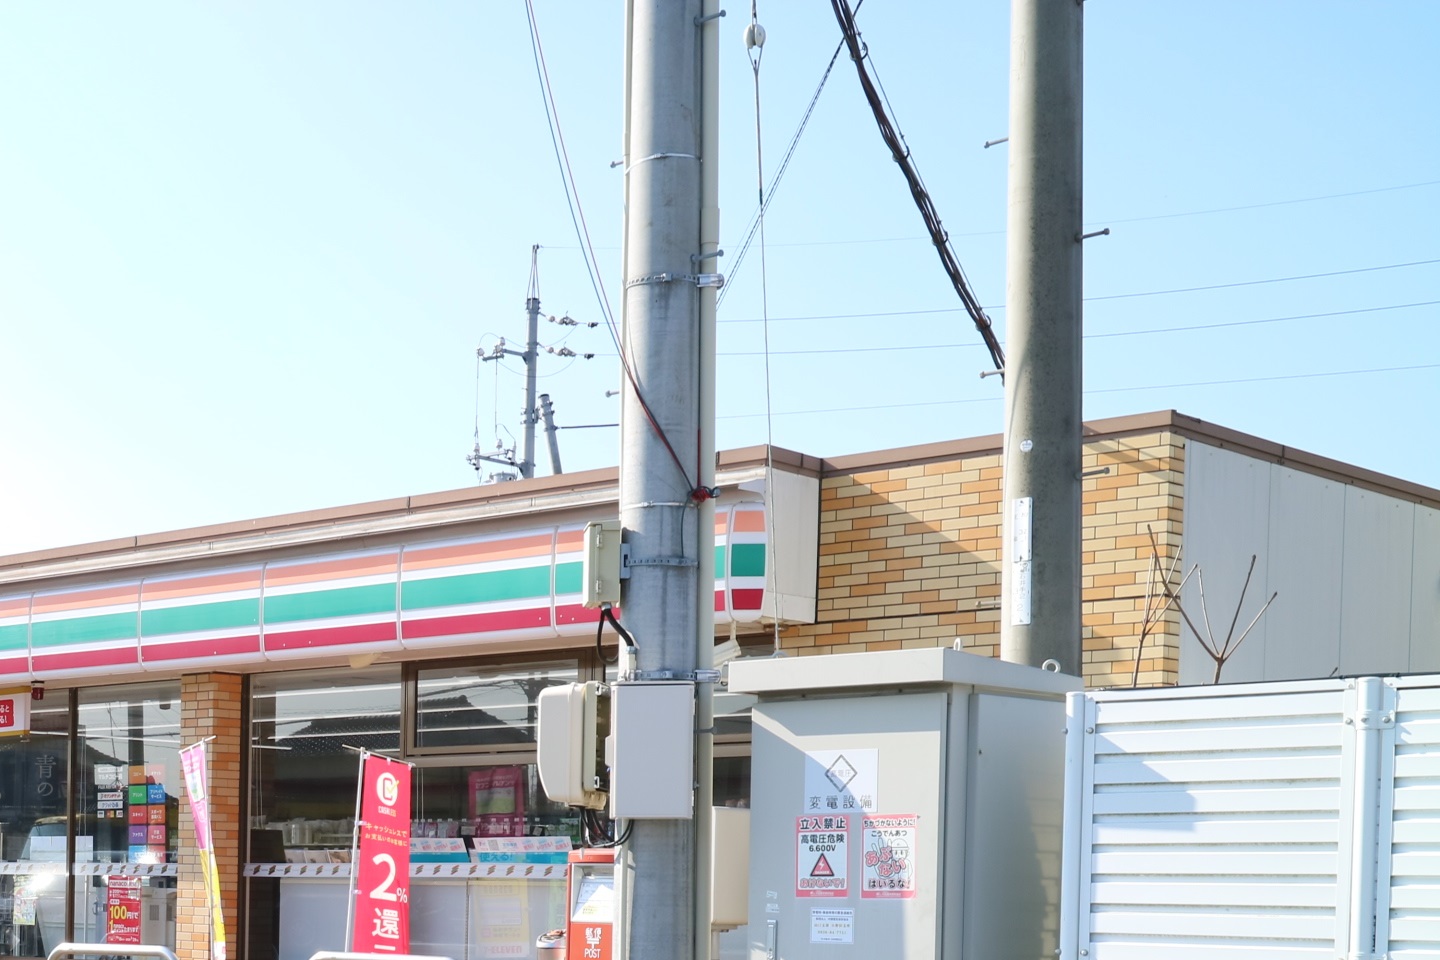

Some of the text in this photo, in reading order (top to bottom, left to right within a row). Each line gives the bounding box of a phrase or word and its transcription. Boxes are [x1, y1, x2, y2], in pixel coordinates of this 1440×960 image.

[35, 754, 57, 797] 青の
[809, 794, 873, 810] 変電設備
[799, 817, 846, 830] 立入禁止
[863, 819, 916, 828] ちかづかないように!
[366, 822, 407, 838] キャッシュレスで
[870, 829, 908, 838] こうでんあつ
[800, 833, 845, 844] 高電圧危険
[867, 878, 911, 890] はいるな!
[585, 927, 602, 939] 郵便
[584, 948, 601, 958] POST
